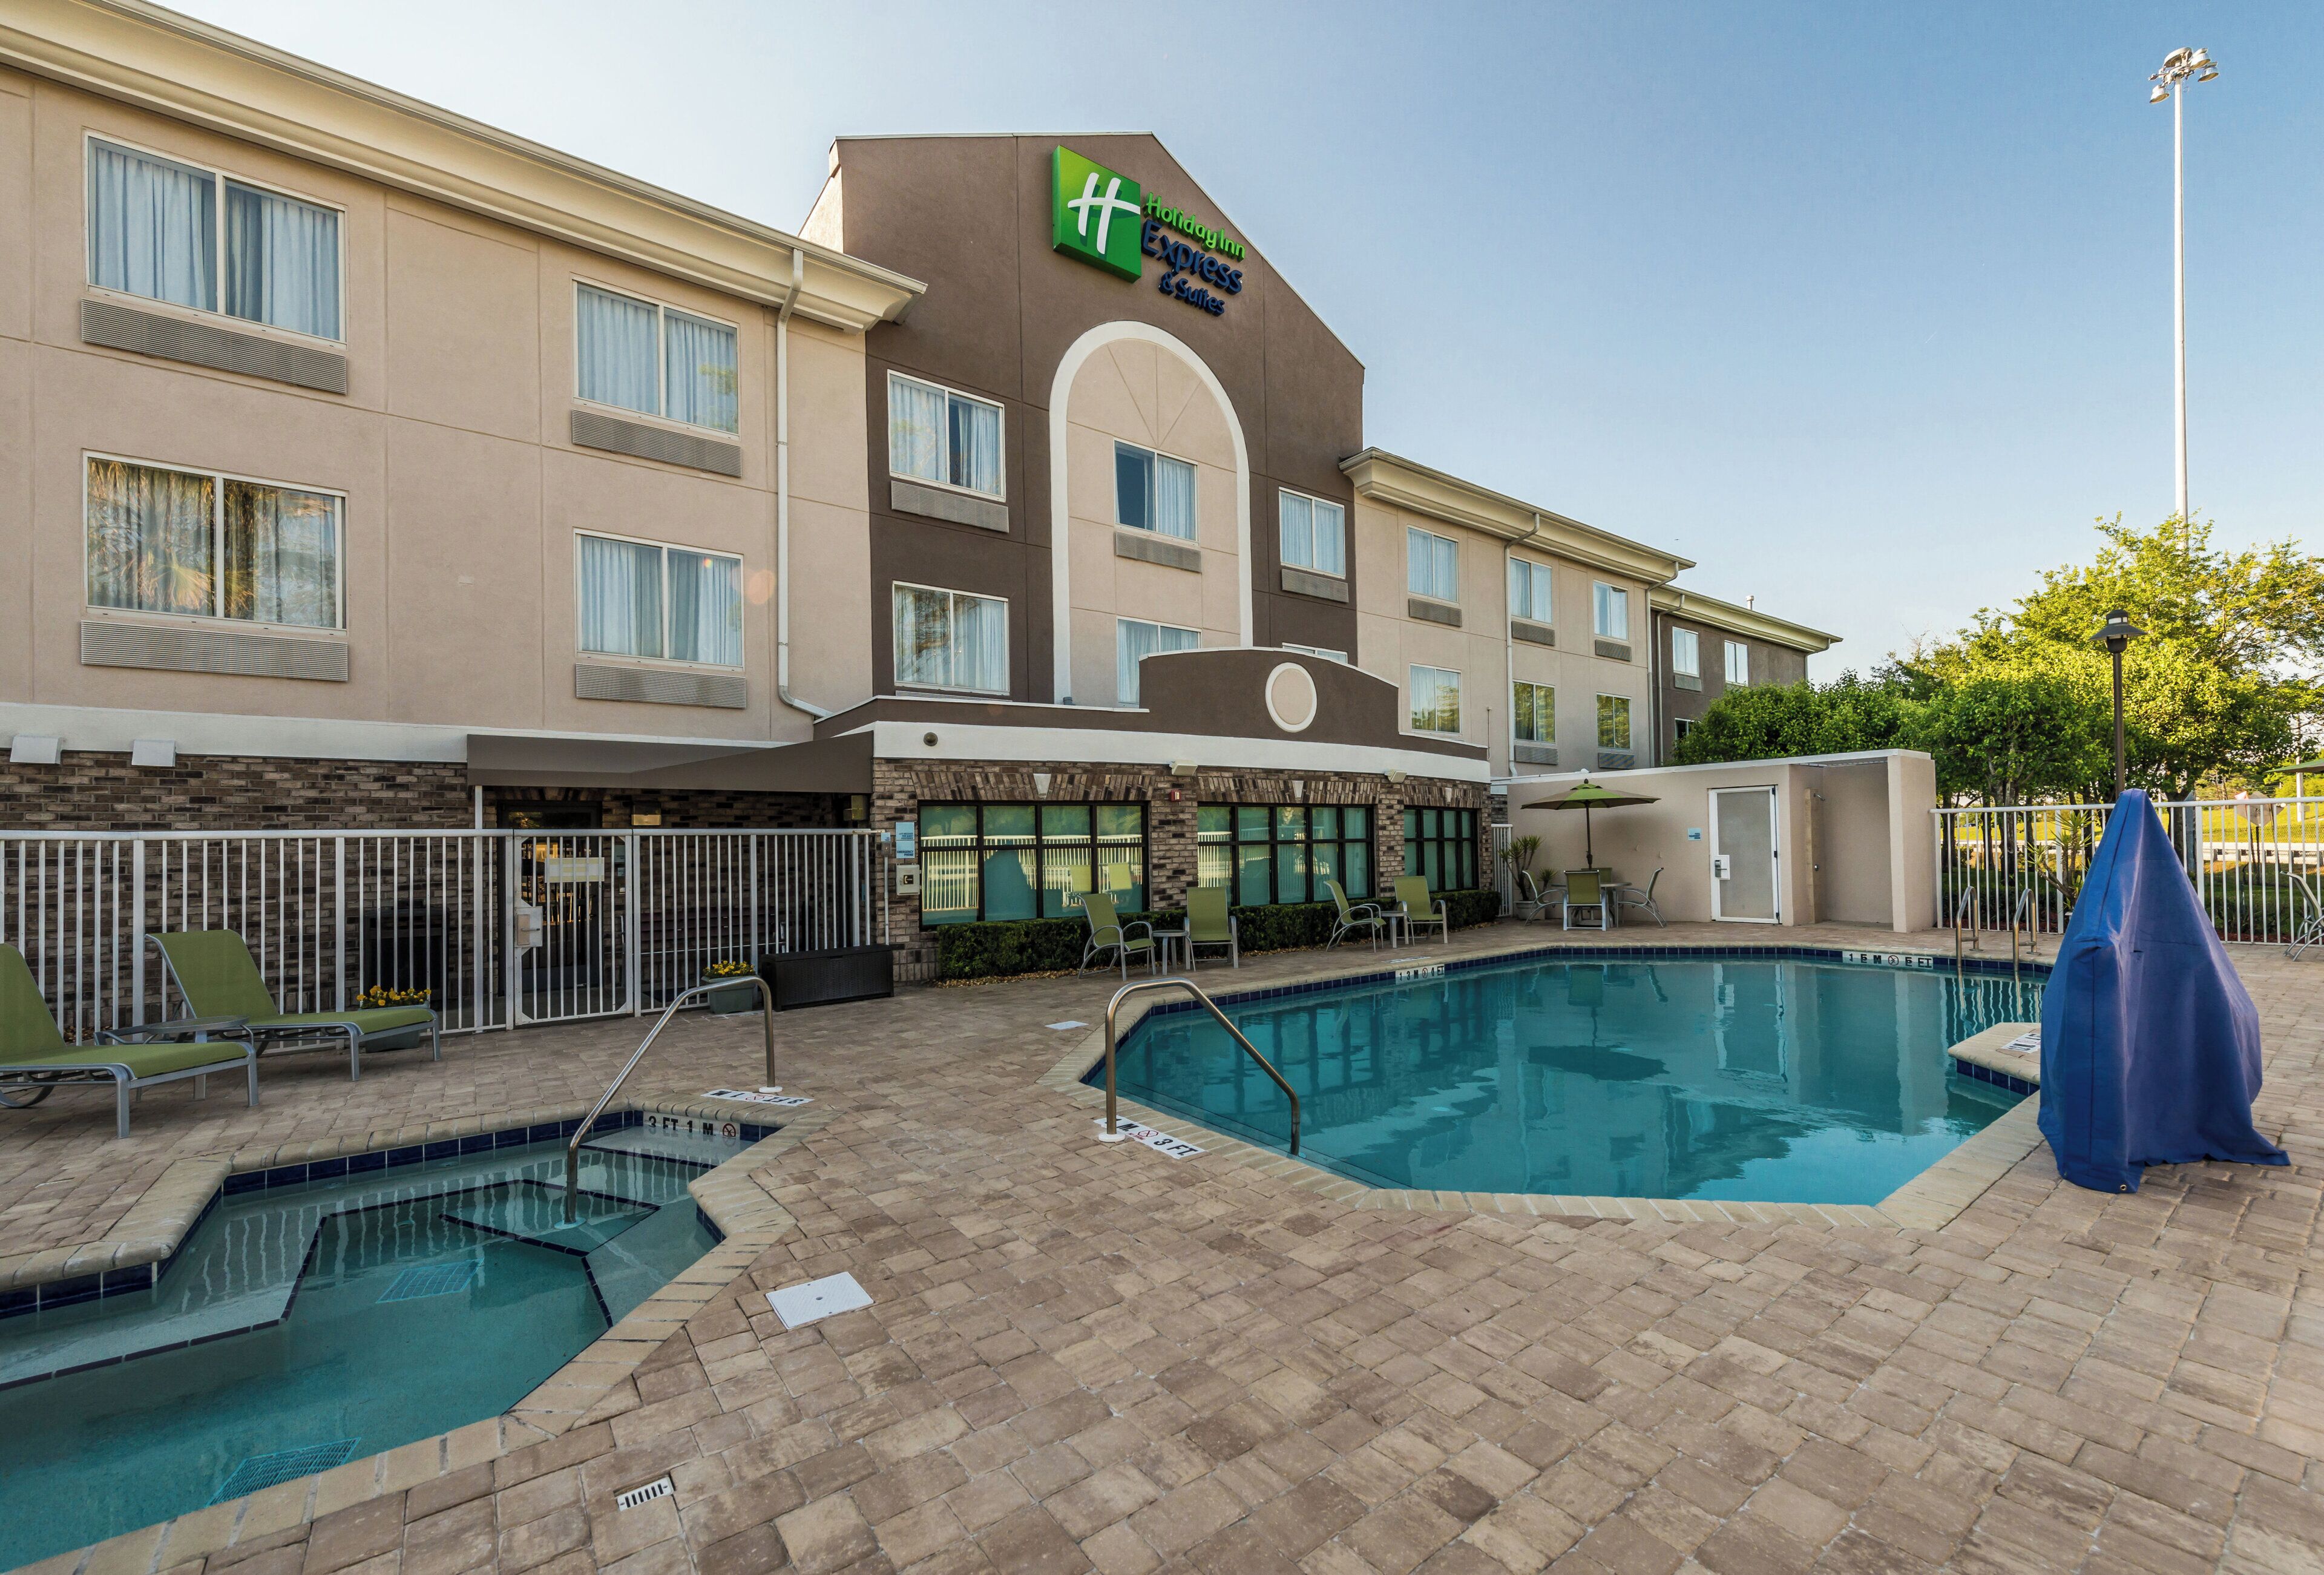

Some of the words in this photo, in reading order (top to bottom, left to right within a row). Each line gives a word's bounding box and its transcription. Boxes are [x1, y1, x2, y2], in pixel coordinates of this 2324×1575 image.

[1144, 192, 1218, 252] Holiday
[1219, 228, 1246, 261] Inn
[1141, 219, 1243, 295] Express
[1158, 271, 1174, 295] &
[1175, 278, 1225, 317] Suites
[649, 1116, 657, 1127] 3
